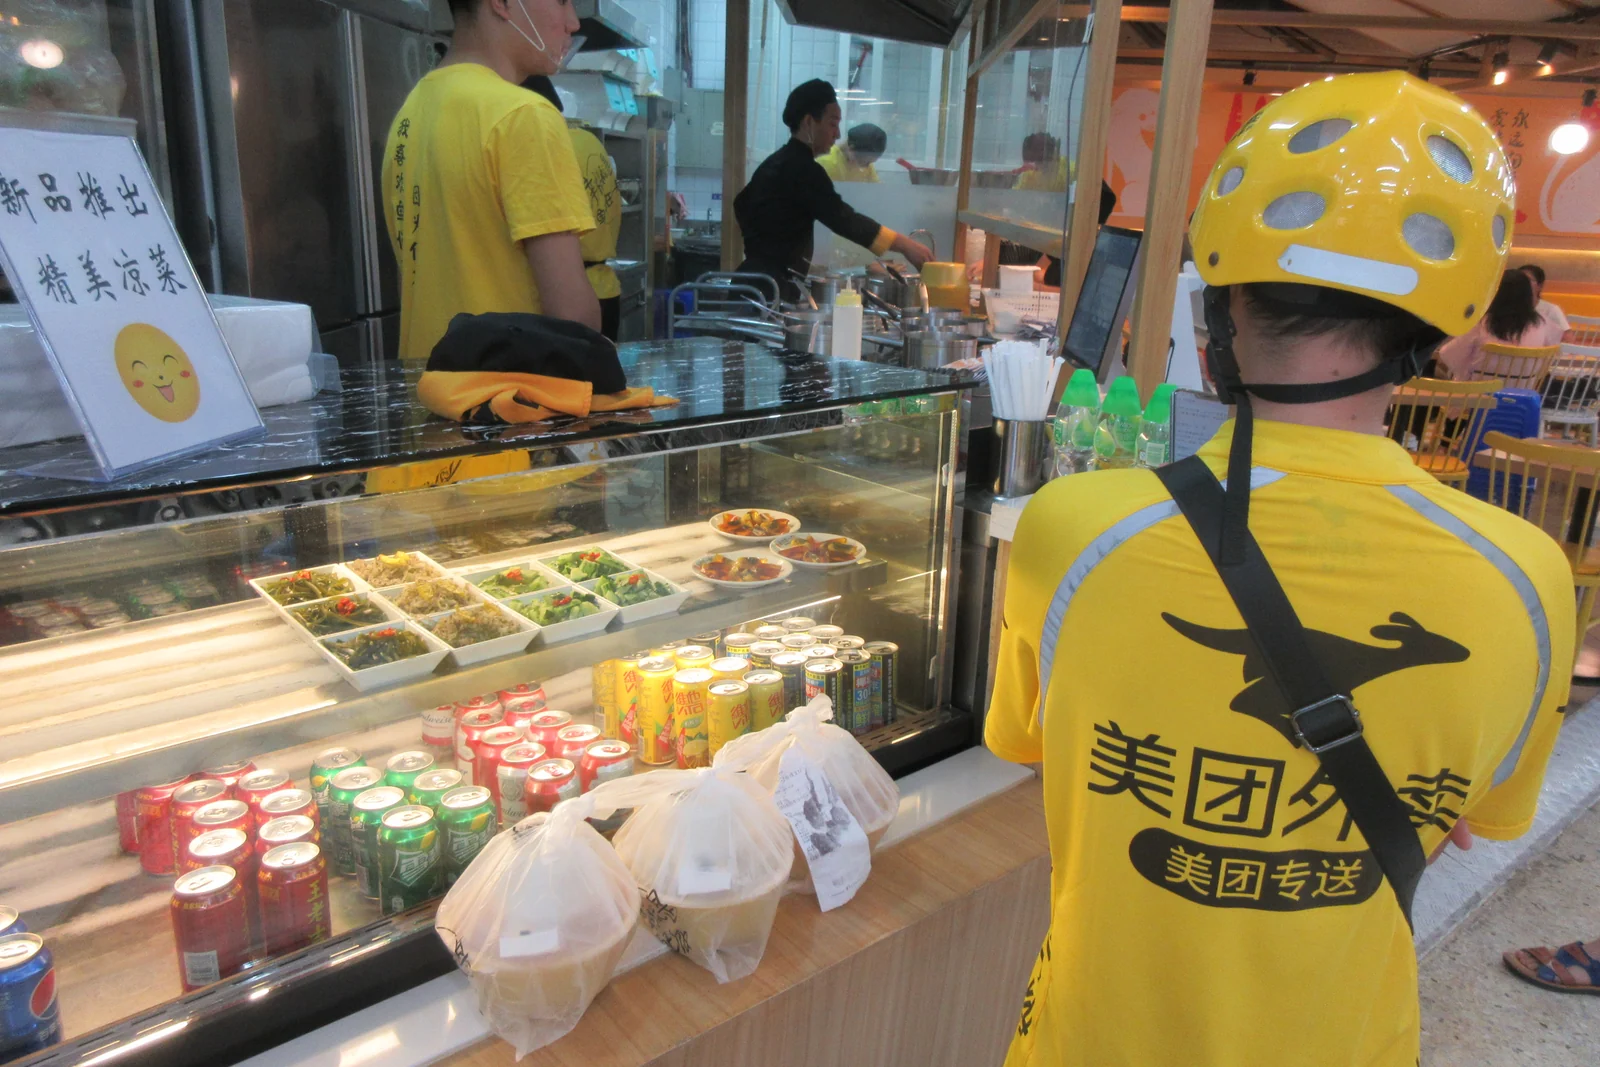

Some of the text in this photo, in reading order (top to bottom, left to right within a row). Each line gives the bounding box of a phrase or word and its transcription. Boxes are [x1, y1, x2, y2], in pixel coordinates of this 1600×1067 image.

[0, 172, 149, 224] 新品推出
[37, 244, 188, 305] 精美凉菜
[1088, 718, 1473, 843] 美团外卖
[1164, 844, 1363, 902] 美团专送
